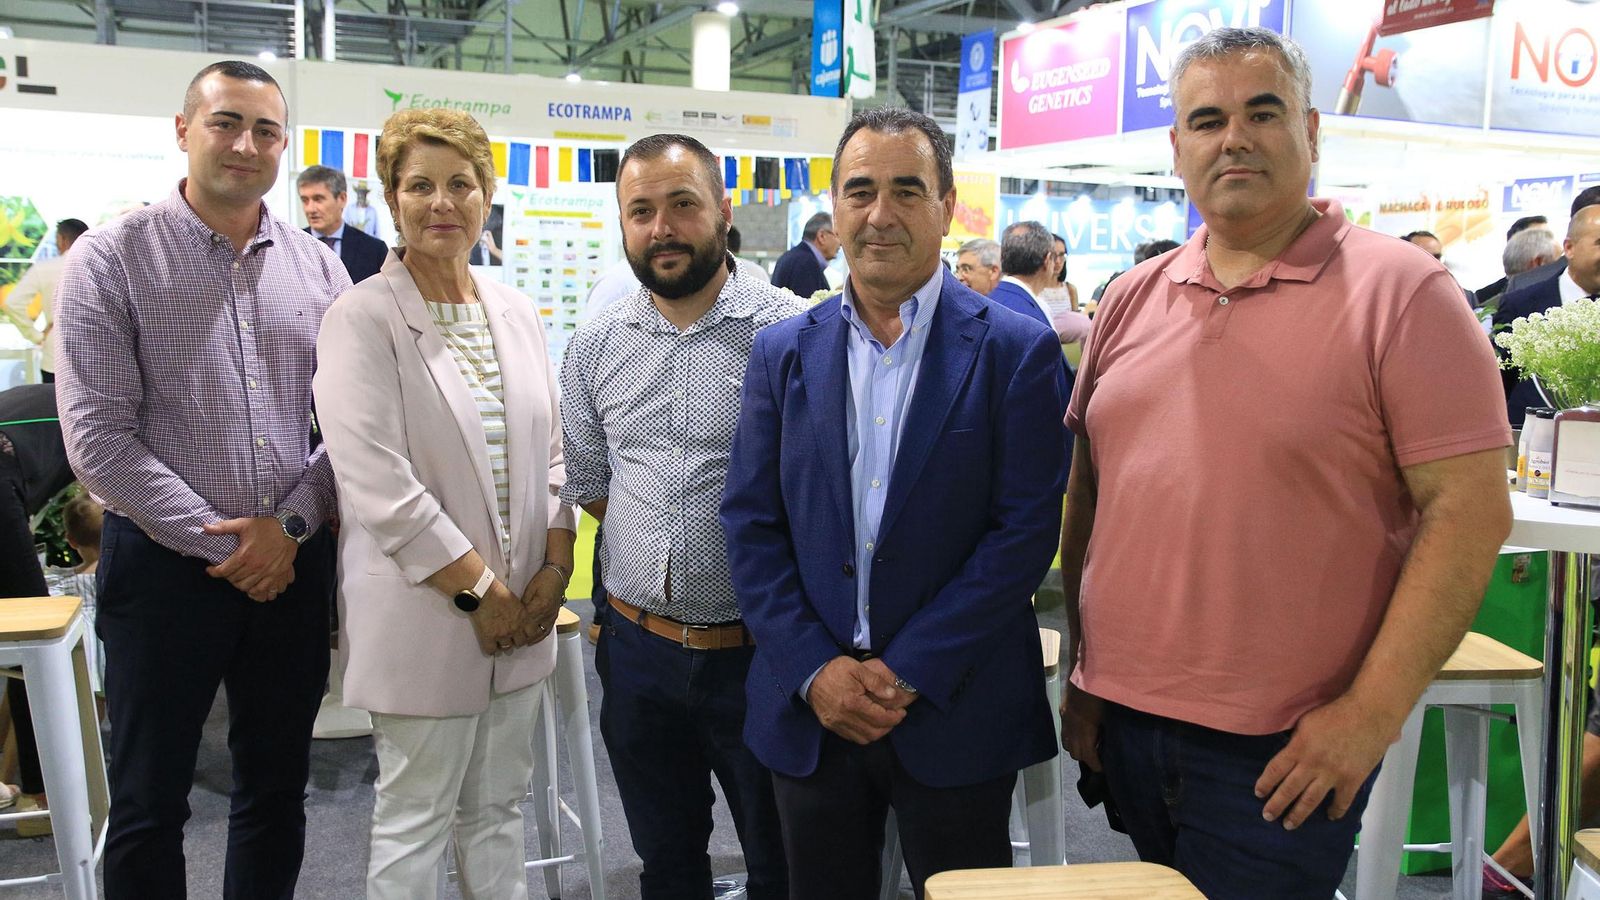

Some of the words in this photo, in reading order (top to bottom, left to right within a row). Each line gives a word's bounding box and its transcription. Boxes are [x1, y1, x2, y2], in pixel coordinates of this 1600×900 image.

[409, 93, 512, 118] Ecotrampa
[548, 102, 632, 122] ECOTRAMPA
[1028, 84, 1093, 114] GENETICS
